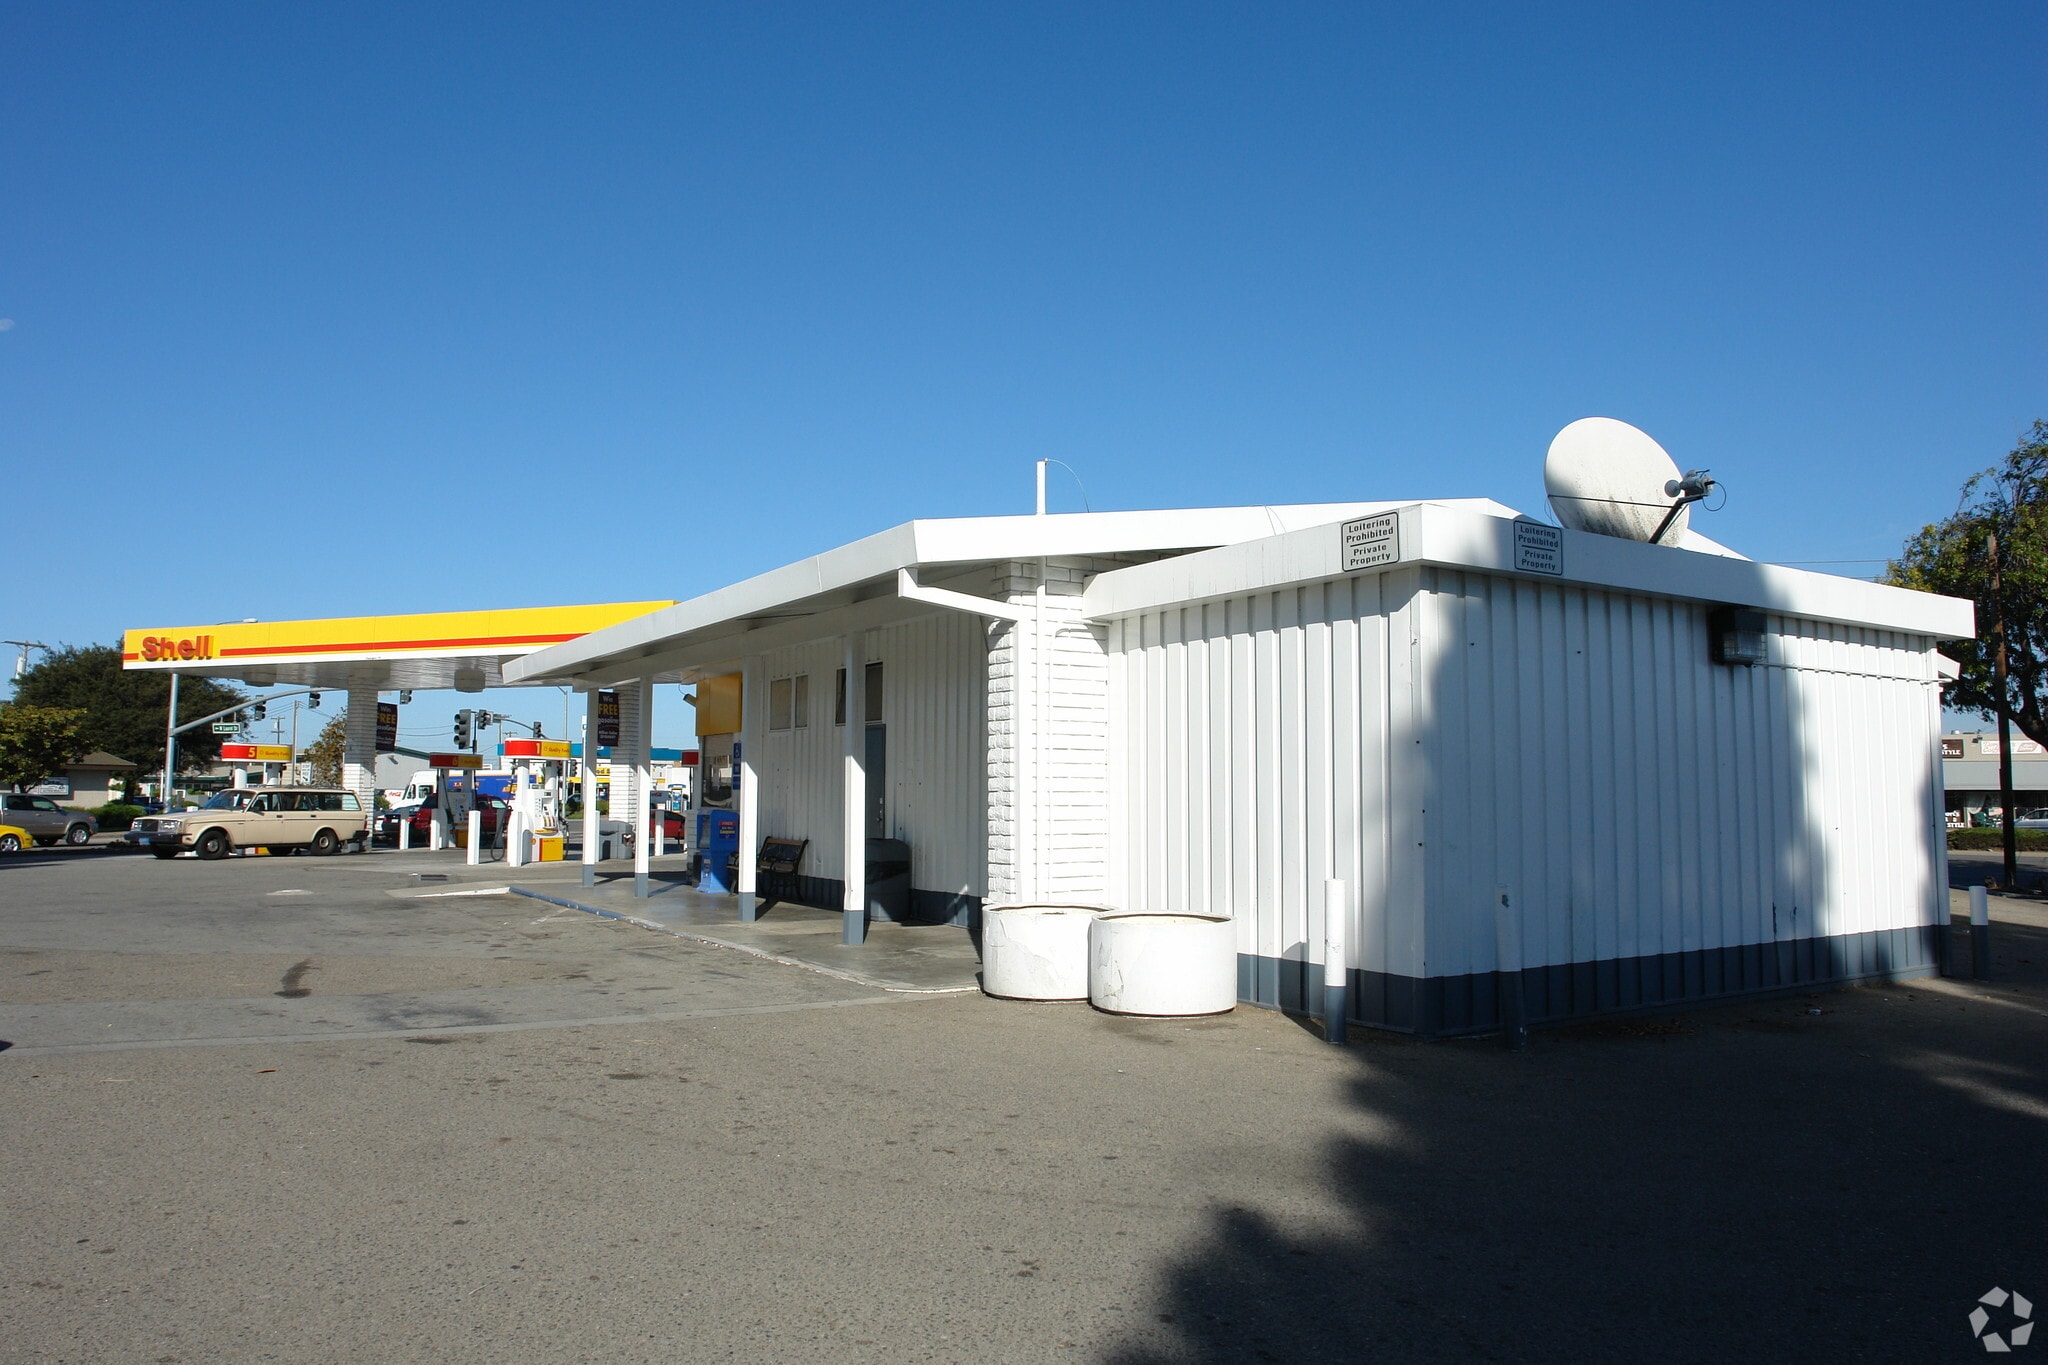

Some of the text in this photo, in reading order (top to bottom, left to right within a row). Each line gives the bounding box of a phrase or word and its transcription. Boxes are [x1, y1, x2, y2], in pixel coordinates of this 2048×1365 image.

[1349, 519, 1390, 533] Loitering
[1520, 525, 1556, 539] Loitering
[1346, 526, 1393, 543] Prohibited
[1518, 535, 1558, 548] Prohibited
[1353, 544, 1387, 556] Private
[1524, 550, 1553, 561] Private
[1350, 553, 1391, 566] Property
[1521, 559, 1556, 571] Property
[141, 635, 212, 659] Shell
[598, 704, 618, 715] FREE
[377, 724, 396, 732] asoline
[248, 747, 256, 758] 5
[535, 743, 540, 754] 1
[452, 757, 458, 766] 6
